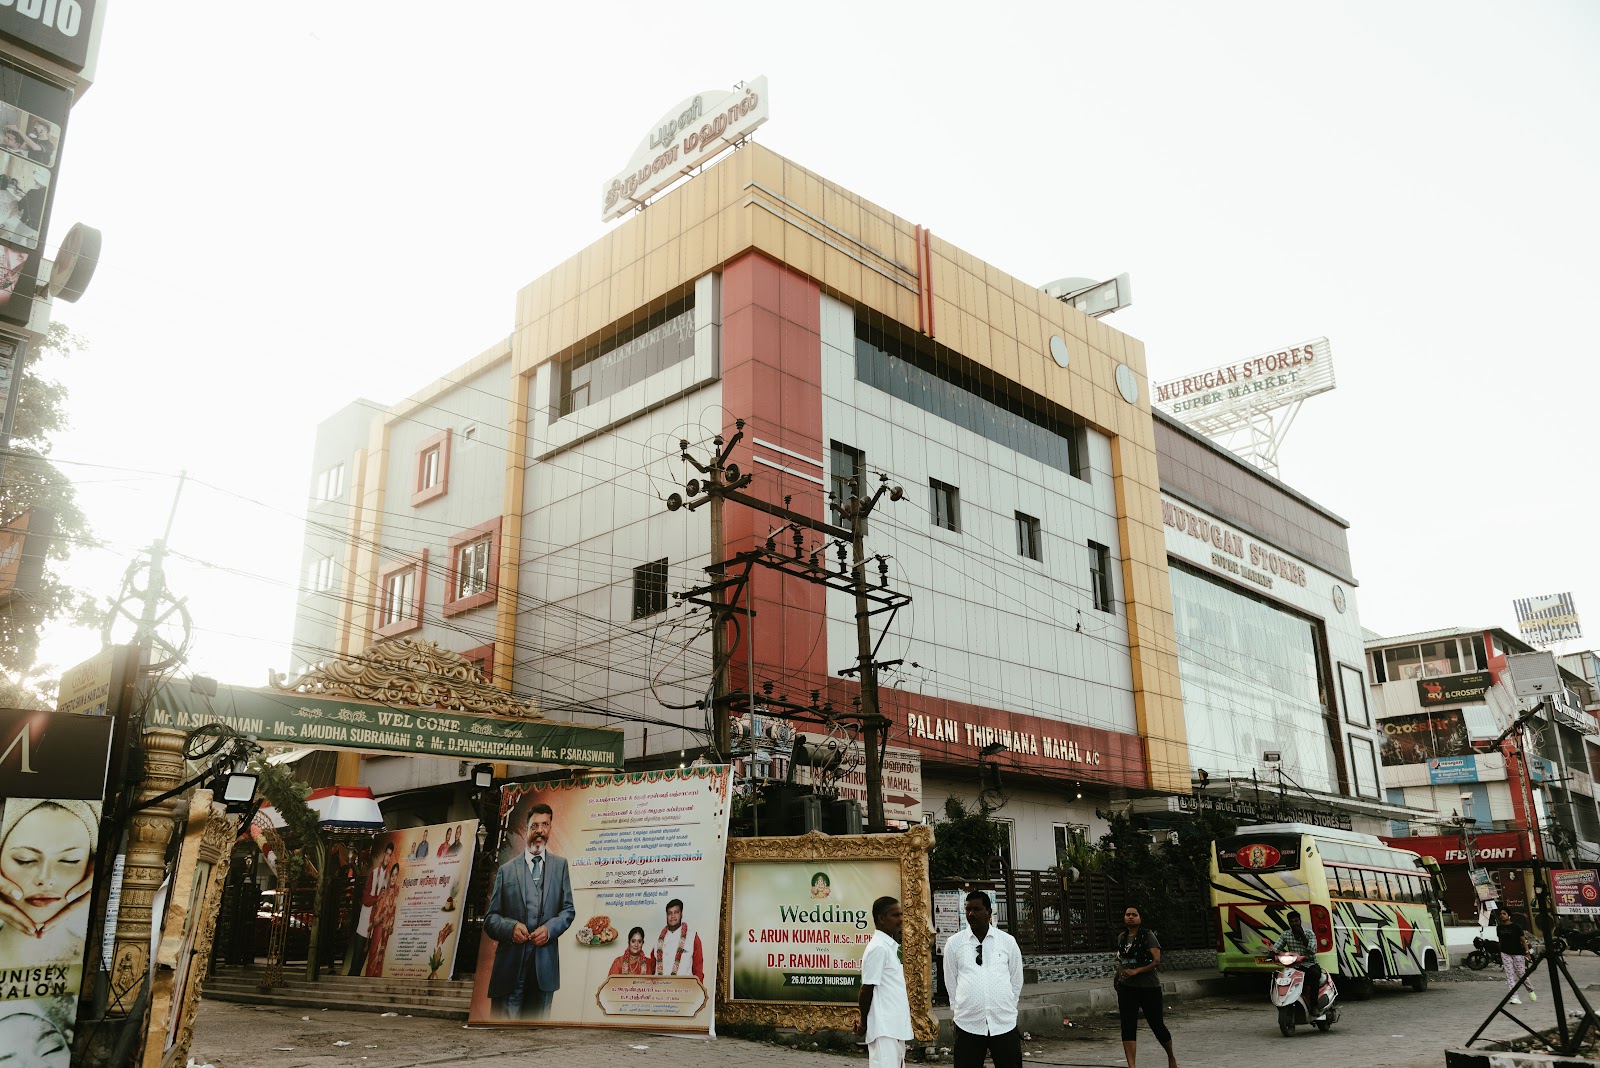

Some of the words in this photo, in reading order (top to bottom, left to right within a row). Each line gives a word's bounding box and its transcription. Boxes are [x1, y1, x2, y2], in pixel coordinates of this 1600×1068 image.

[650, 95, 703, 150] பழனி
[603, 143, 680, 214] திருமண
[662, 312, 695, 340] MAHA
[1156, 366, 1238, 403] MURUGAN
[1243, 344, 1315, 380] STORES
[1173, 392, 1224, 413] SUPER
[1227, 371, 1301, 399] MARKET
[1161, 499, 1245, 559] MURUGAN
[1250, 543, 1307, 588] STORES
[1211, 552, 1240, 575] SUPER
[1240, 563, 1274, 590] MARKET
[1450, 687, 1485, 698] CROSSFIT
[416, 716, 460, 733] COME
[152, 708, 173, 726] Mr.
[273, 721, 298, 738] Mrs.
[300, 724, 348, 742] AMUDHA
[350, 727, 411, 748] SUBRAMANI
[415, 735, 425, 748] &
[431, 736, 446, 750] Mr.
[448, 738, 534, 758] D.PANCHATCHARAM
[541, 747, 559, 760] Mrs.
[560, 748, 616, 764] P.SARASWATHI
[907, 713, 959, 744] PALANI
[965, 723, 1039, 756] THIRUMANA
[1042, 737, 1083, 763] MAHAL
[1086, 750, 1100, 765] A/C
[887, 775, 912, 792] MAHAL
[841, 786, 859, 801] MINI
[1314, 814, 1340, 828] STORES
[594, 850, 704, 867] தொல்.திருமாவளவன்
[1445, 850, 1467, 860] IFB
[1471, 848, 1517, 859] POINT
[1561, 894, 1576, 904] 15
[779, 904, 869, 929] Wedding
[748, 929, 758, 943] S.
[760, 929, 789, 943] ARUN
[792, 930, 831, 944] KUMAR
[833, 934, 854, 945] M.Sc.,
[767, 953, 787, 968] D.P.
[789, 953, 831, 969] RANJINI
[791, 975, 823, 985] 26.01.2023
[824, 976, 855, 986] THURSDAY
[0, 982, 66, 999] ALON
